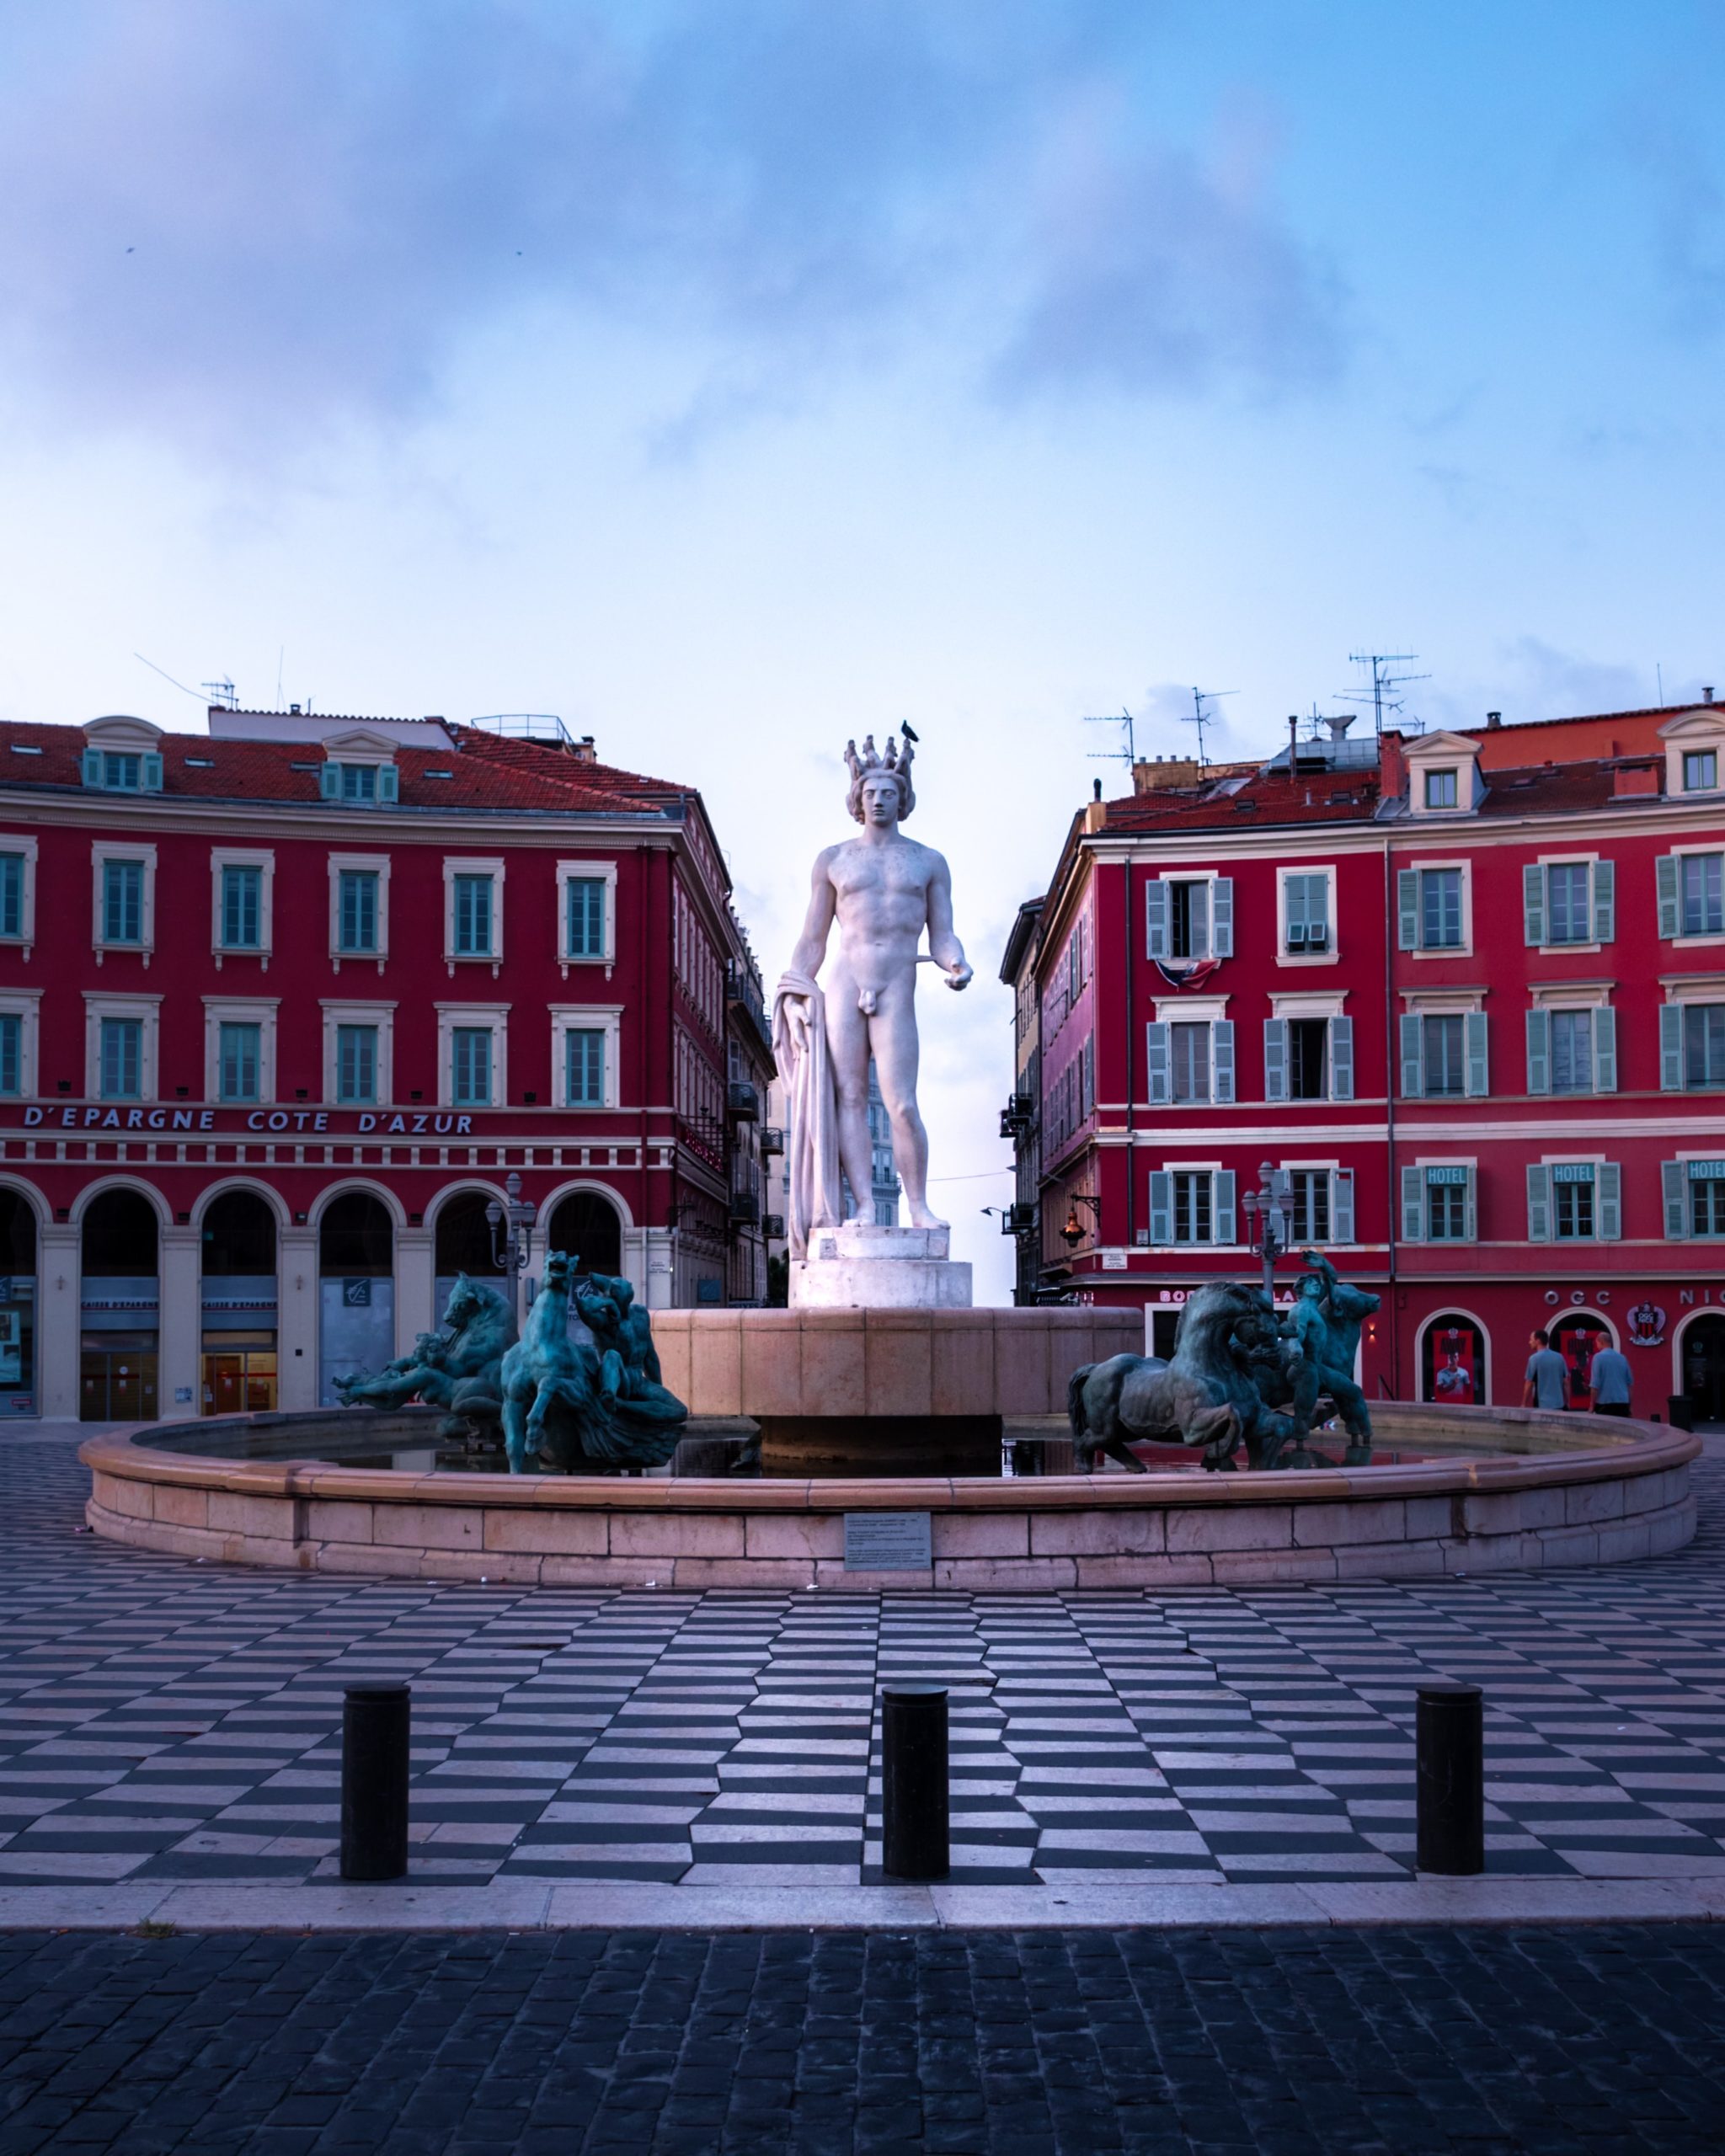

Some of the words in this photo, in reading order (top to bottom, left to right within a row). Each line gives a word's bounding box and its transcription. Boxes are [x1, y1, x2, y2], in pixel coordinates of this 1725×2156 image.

[24, 1106, 215, 1129] D'EPARGNE
[247, 1110, 329, 1132] COTE
[358, 1113, 473, 1134] D'AZUR
[1429, 1167, 1466, 1184] HOTEL
[1555, 1166, 1593, 1182] HOTEL
[1544, 1290, 1610, 1305] OGC
